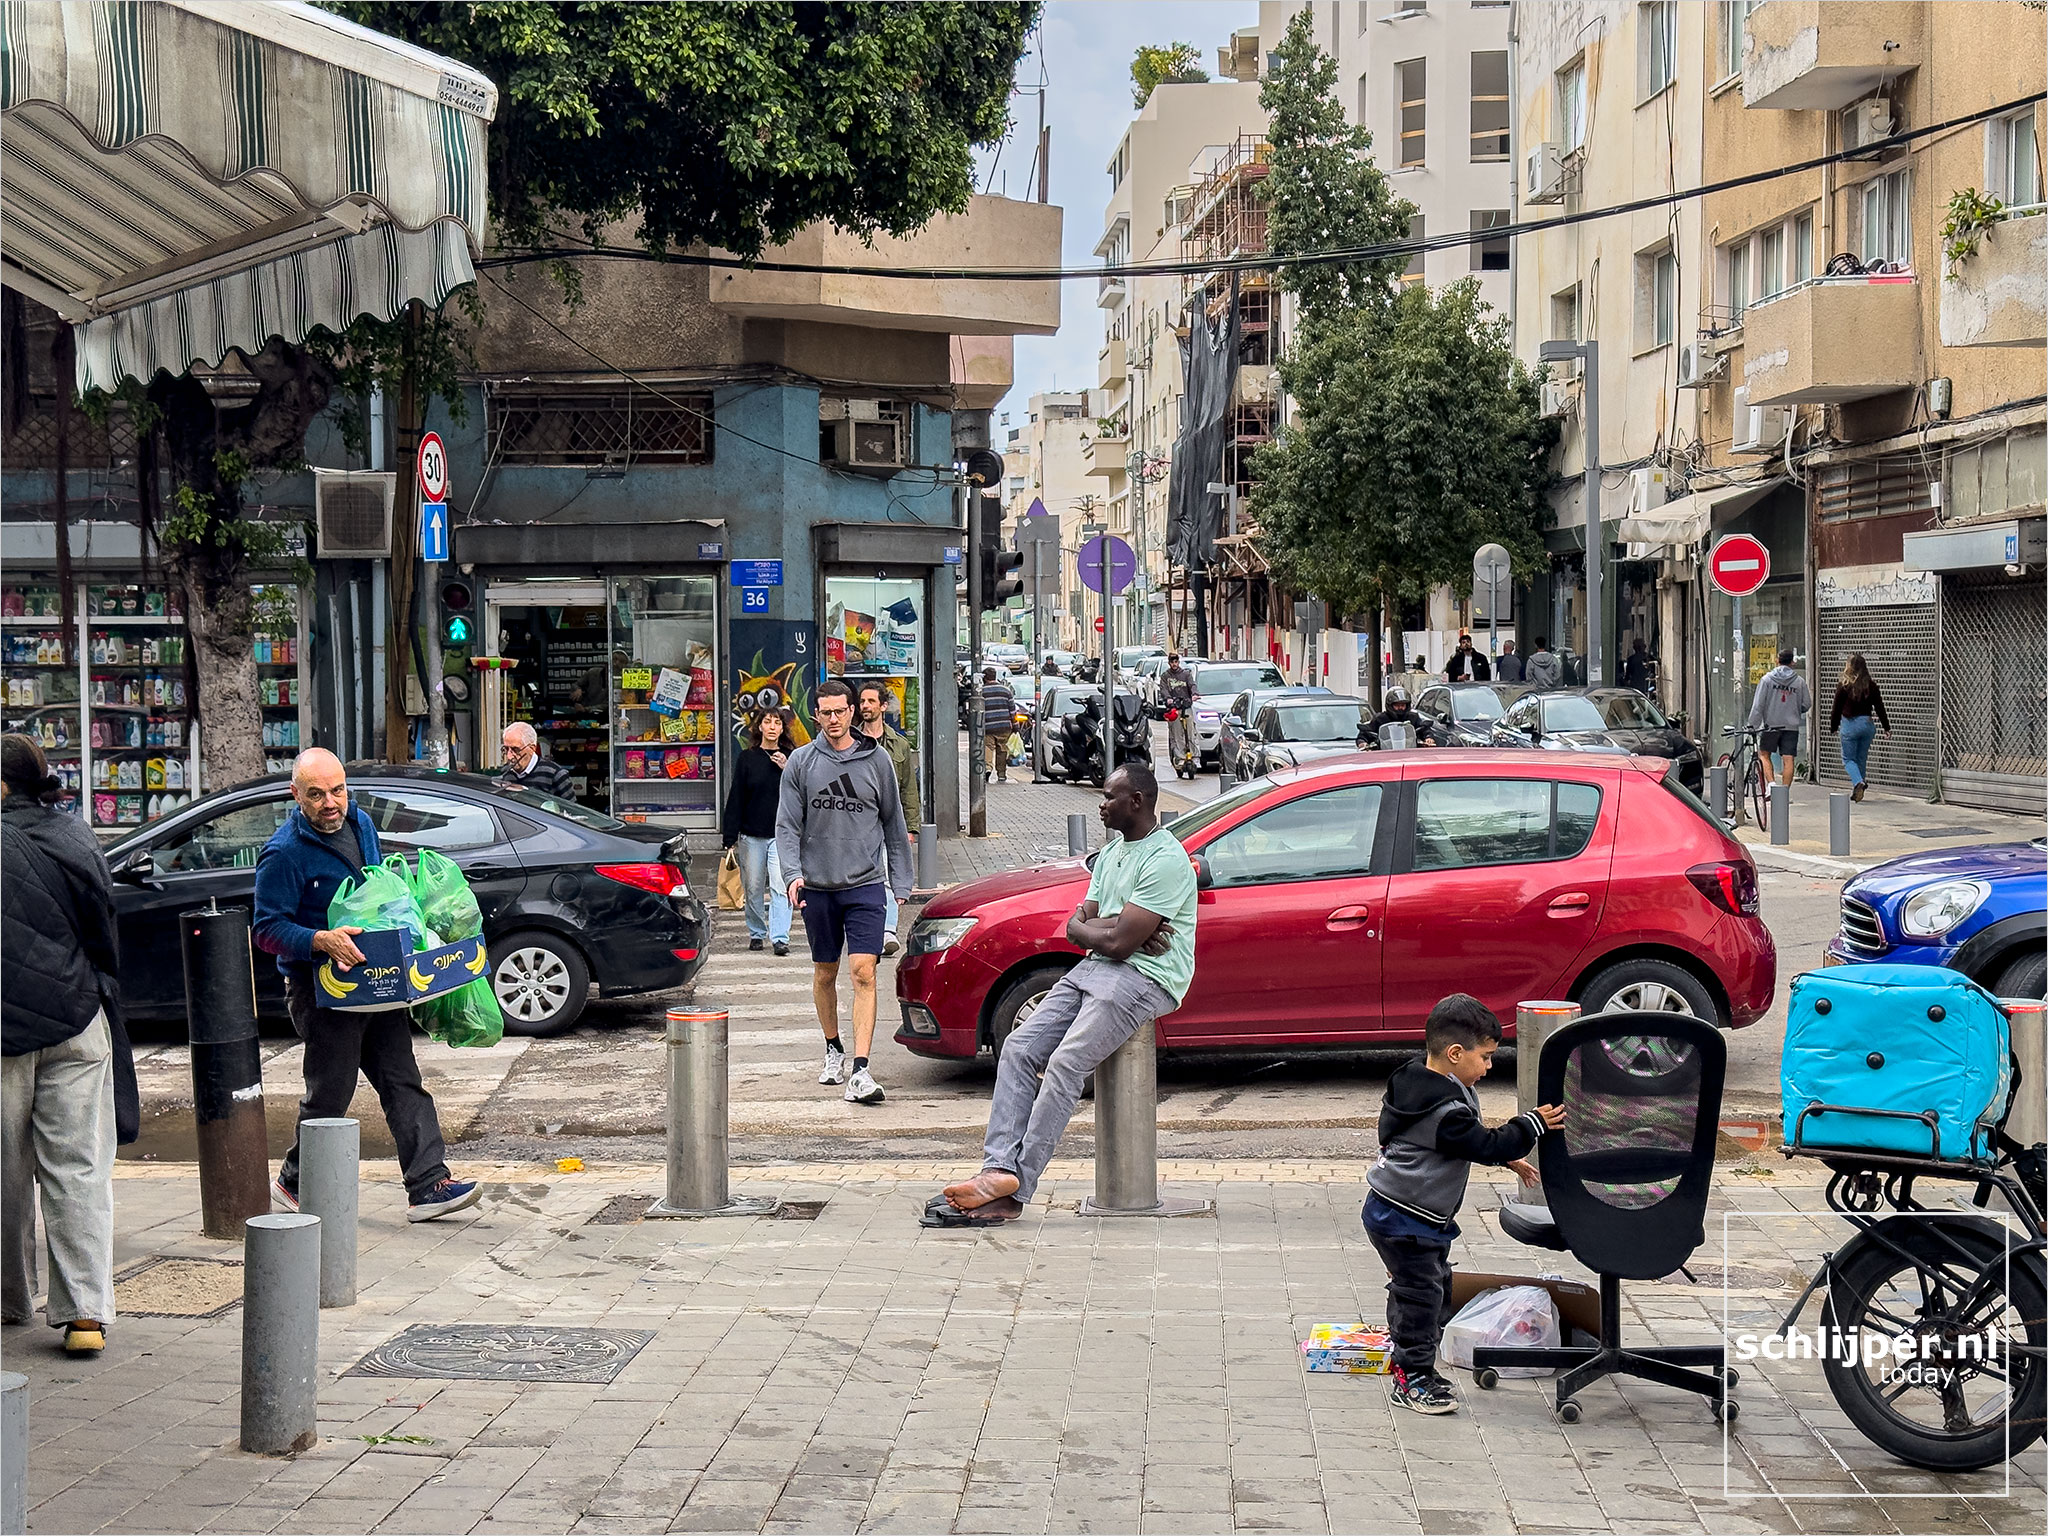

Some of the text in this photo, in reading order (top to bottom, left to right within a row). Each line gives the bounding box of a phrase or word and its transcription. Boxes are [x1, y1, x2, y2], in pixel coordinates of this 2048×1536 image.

[425, 452, 441, 482] 30
[2006, 540, 2015, 556] 41
[746, 592, 765, 606] 36
[811, 796, 864, 813] adidas
